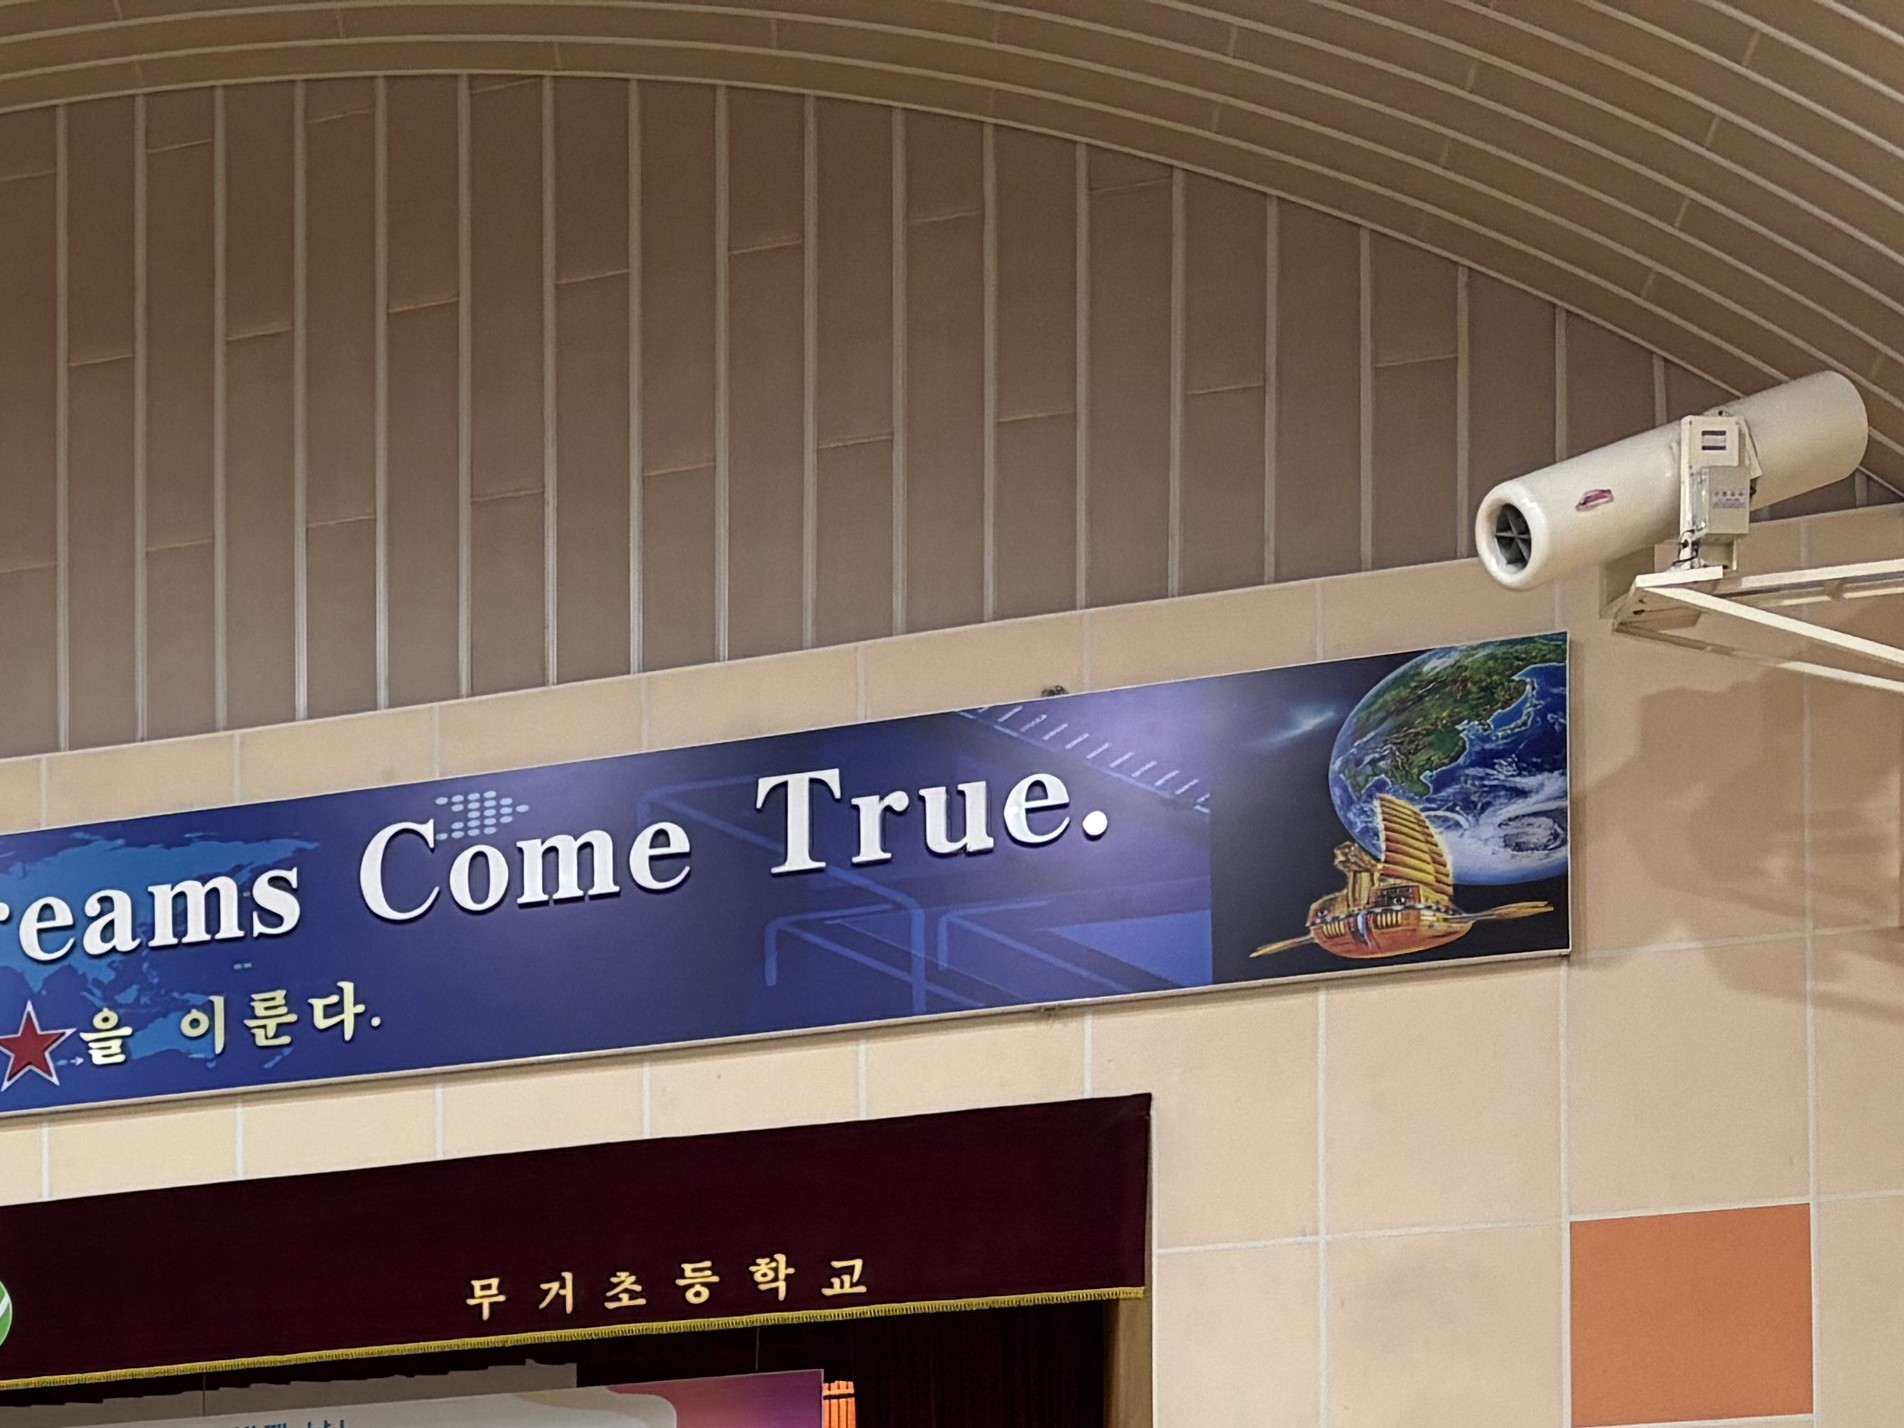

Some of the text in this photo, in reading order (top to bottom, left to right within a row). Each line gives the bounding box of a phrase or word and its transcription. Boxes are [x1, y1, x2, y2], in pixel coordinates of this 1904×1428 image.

[359, 817, 691, 922] Come
[755, 767, 1109, 876] True.
[179, 979, 383, 1056] 이룬다.
[465, 1252, 868, 1322] 무거초등학교
